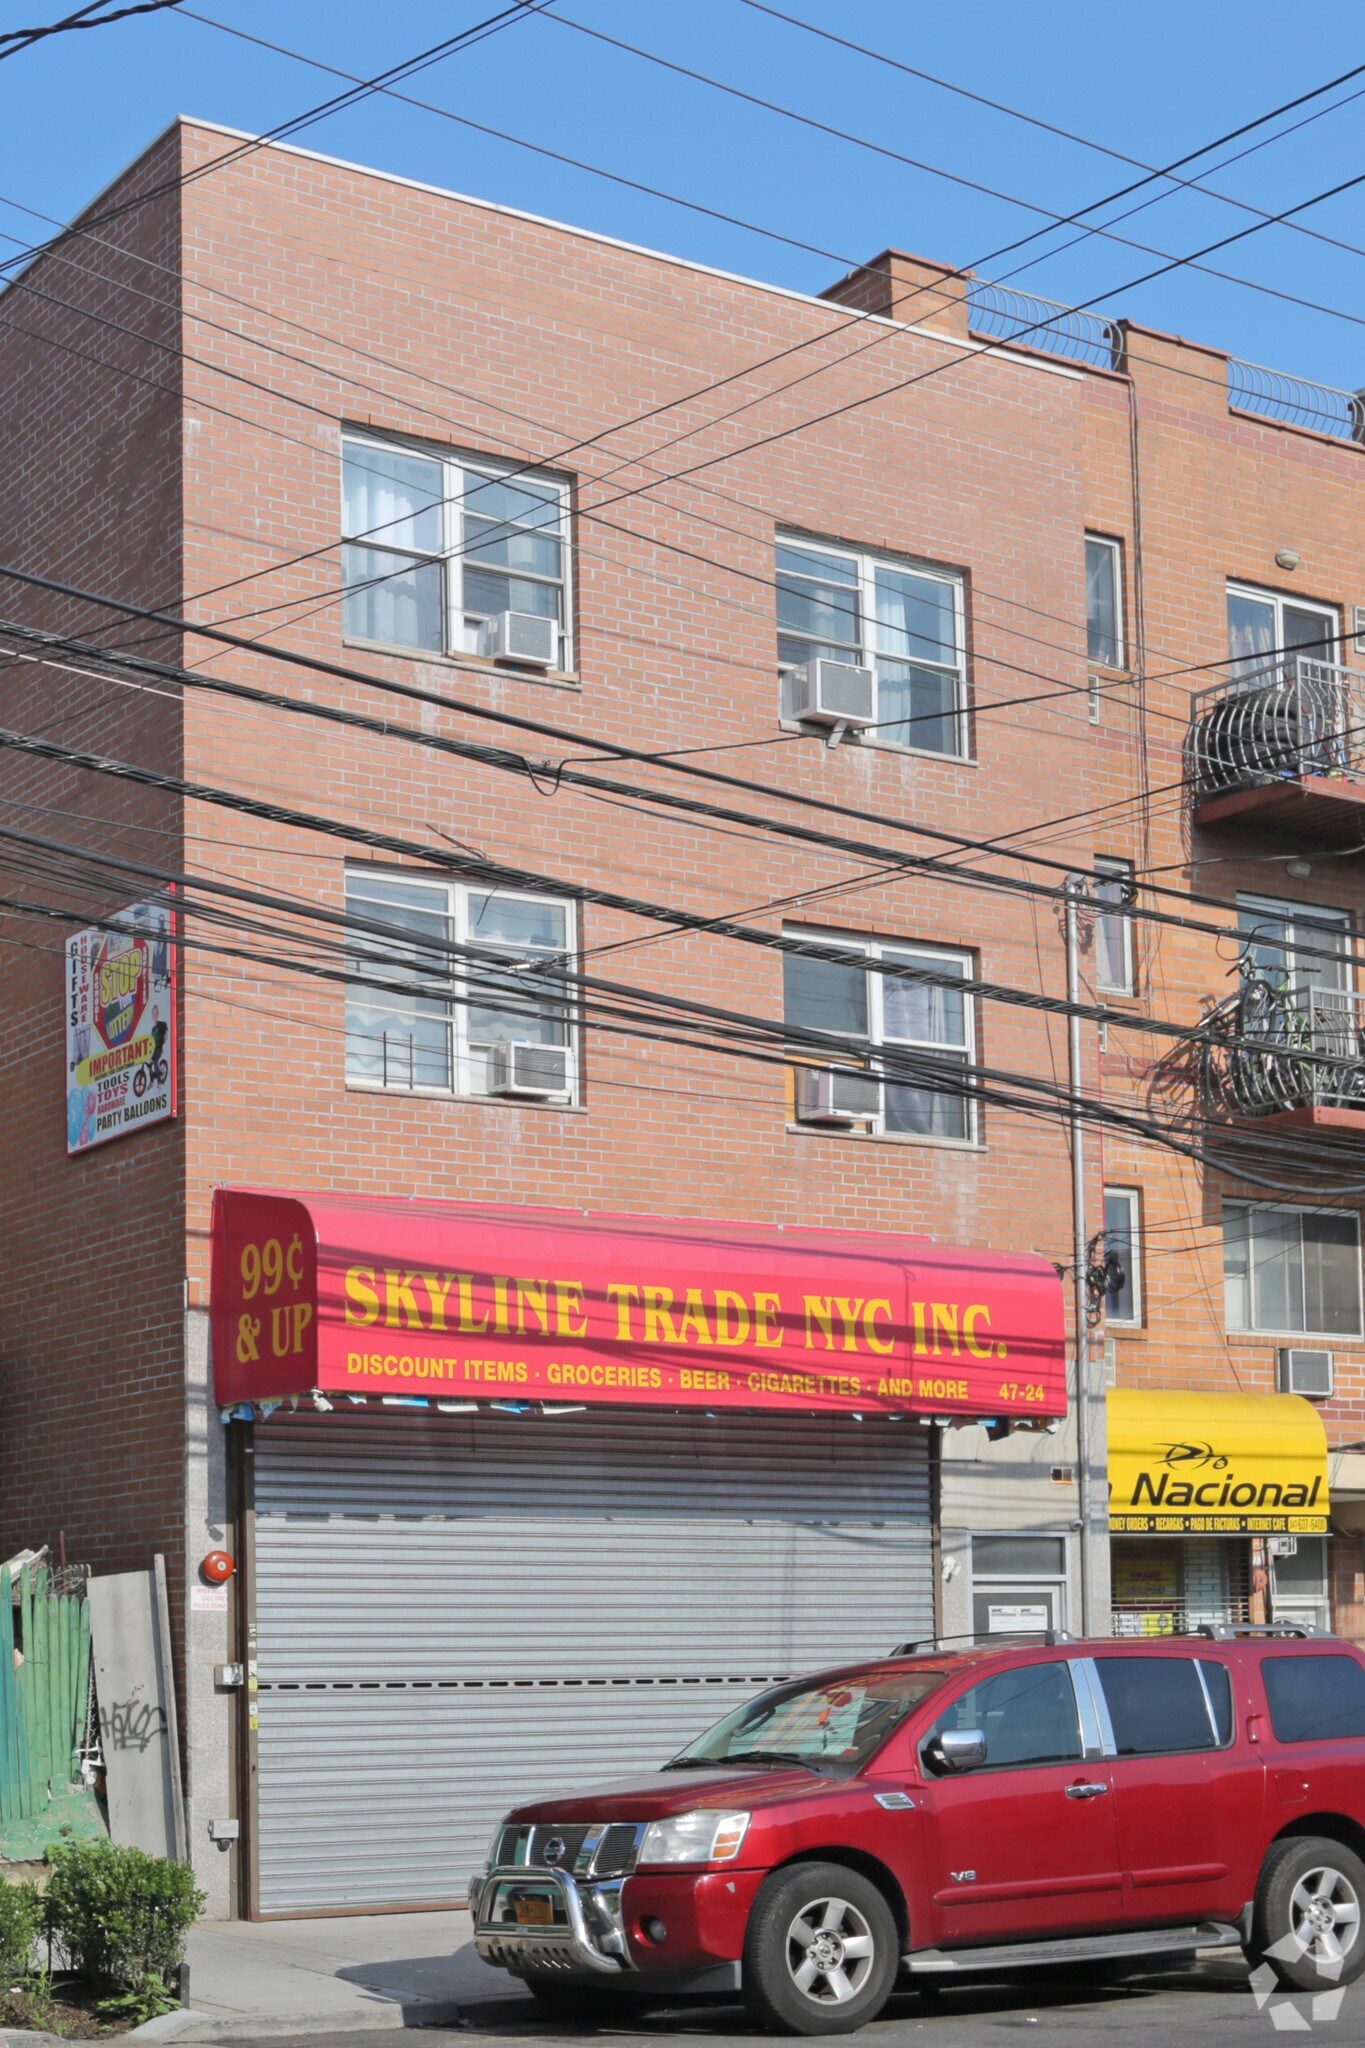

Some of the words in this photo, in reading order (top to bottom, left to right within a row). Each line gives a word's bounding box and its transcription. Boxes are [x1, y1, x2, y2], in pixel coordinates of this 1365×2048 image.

[101, 949, 142, 1006] STOP
[97, 1071, 129, 1092] TOOLS
[97, 1083, 128, 1103] TOYS
[97, 1109, 122, 1132] PARTY
[124, 1094, 167, 1122] BALLOONS
[343, 1265, 589, 1339] SKYLINE
[607, 1283, 784, 1348] TRADE
[802, 1295, 895, 1354] NYC
[912, 1302, 1008, 1360] INC.
[236, 1313, 261, 1363] &
[271, 1302, 313, 1358] UP
[346, 1352, 457, 1379] DISCOUNT
[464, 1360, 528, 1383] ITEMS
[547, 1363, 662, 1388] GROCERIES
[680, 1369, 730, 1391] BEER
[747, 1371, 862, 1396] CIGARETTES
[877, 1377, 913, 1398] AND
[918, 1379, 969, 1400] MORE
[999, 1382, 1045, 1402] 47-24
[1130, 1473, 1322, 1507] Nacional
